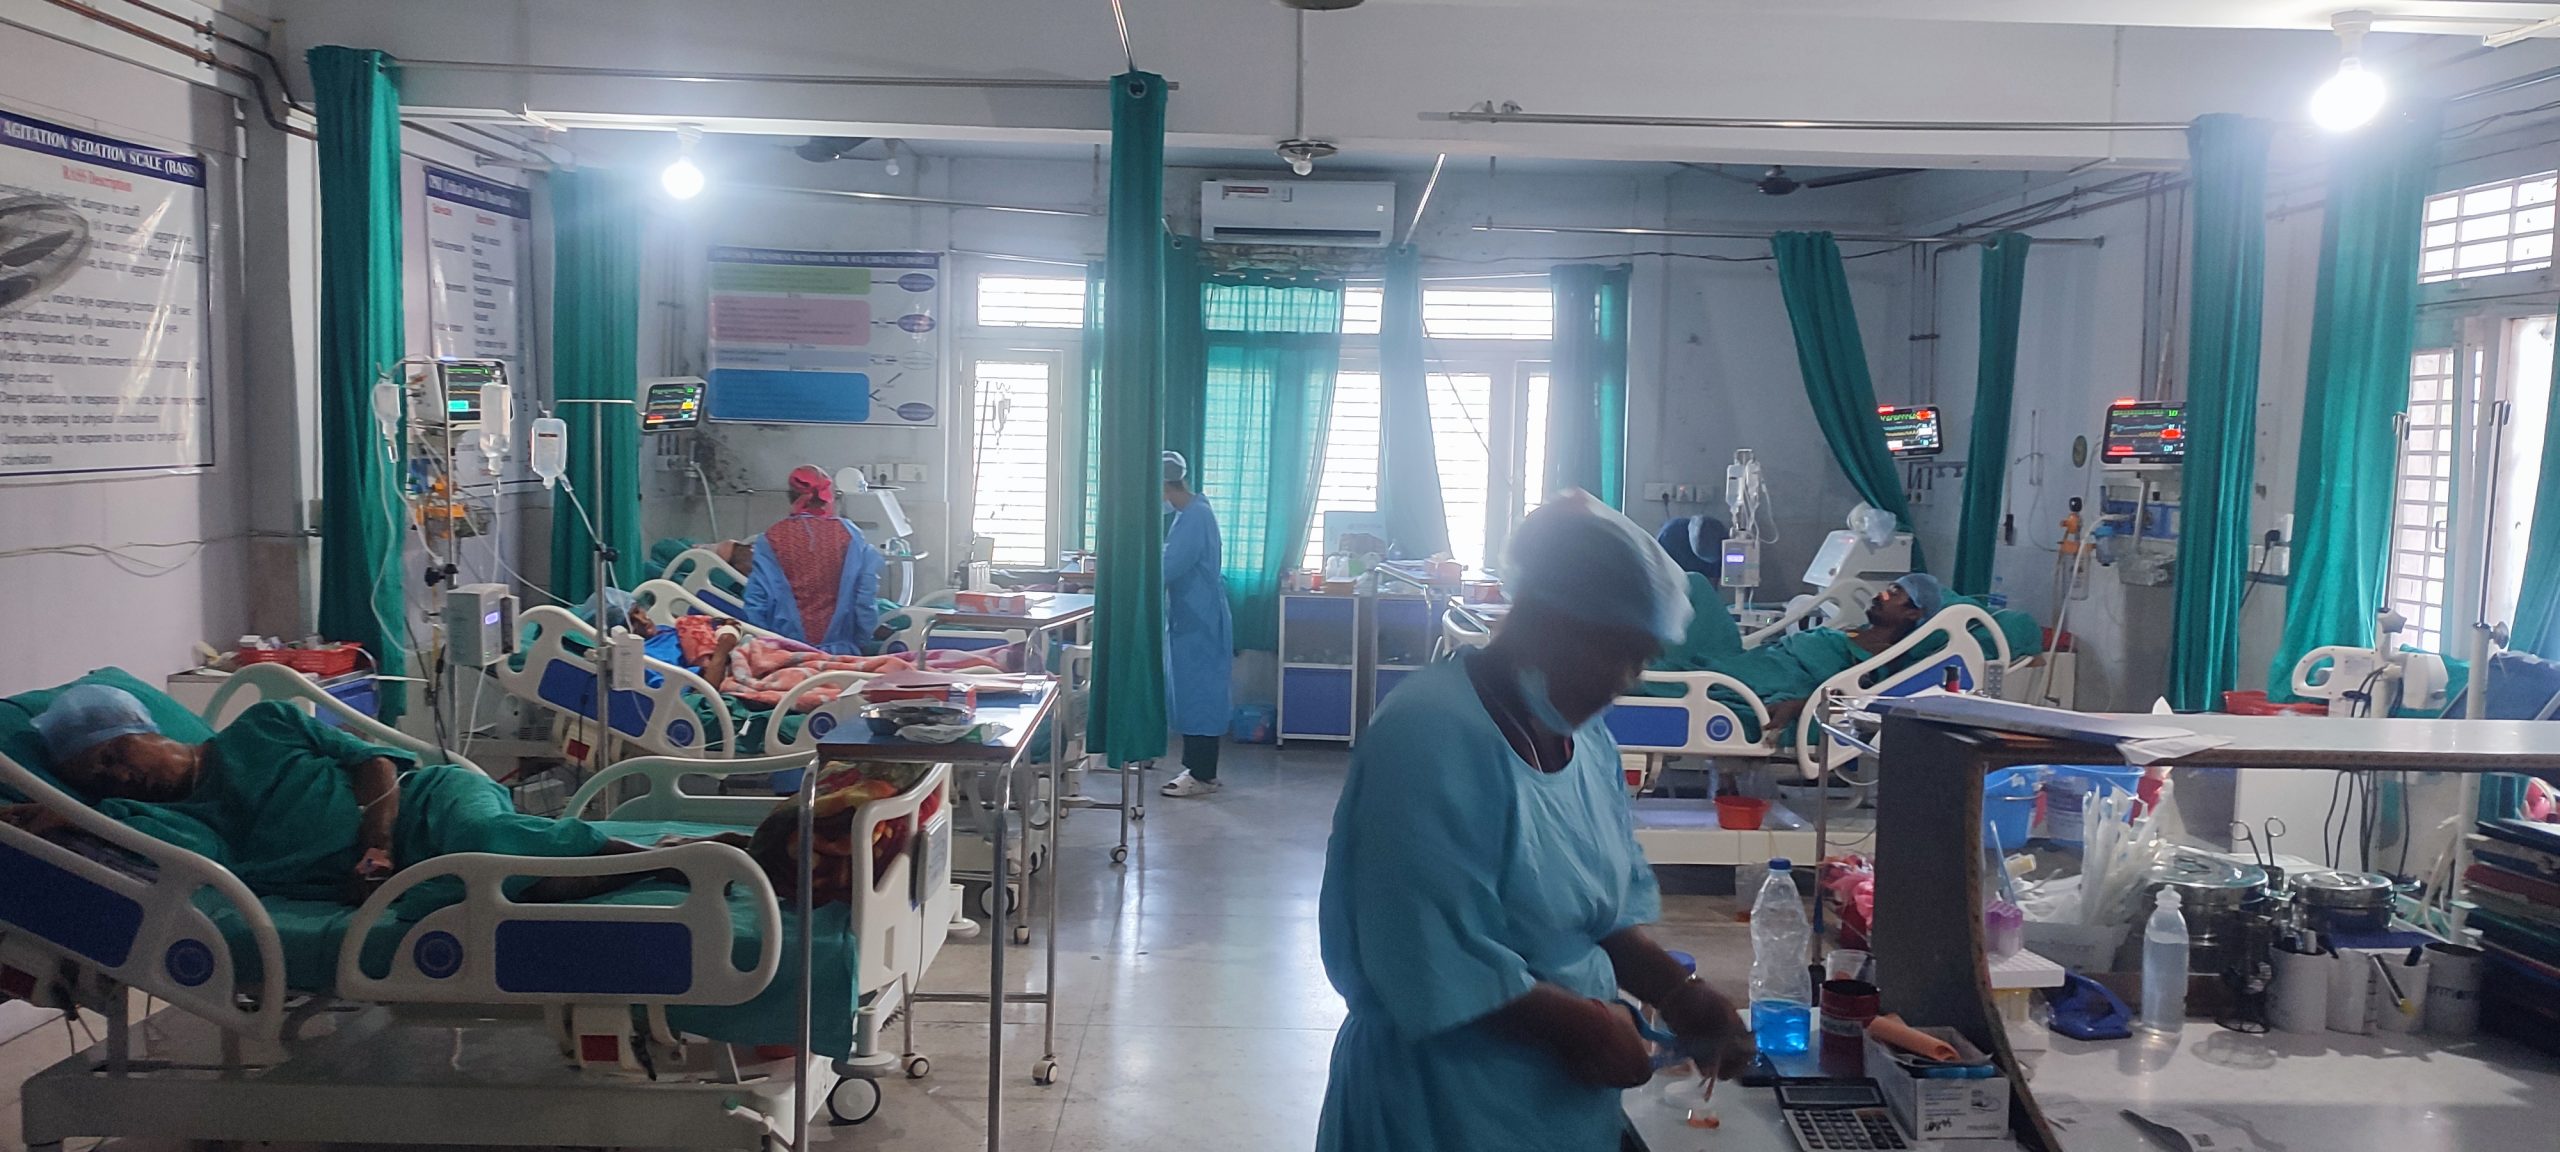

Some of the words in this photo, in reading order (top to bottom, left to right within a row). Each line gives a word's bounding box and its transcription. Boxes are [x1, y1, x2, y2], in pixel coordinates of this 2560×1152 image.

[4, 120, 68, 149] AGITATION
[71, 137, 126, 163] SEDATION
[129, 151, 164, 172] SCALE
[112, 203, 120, 214] to
[66, 312, 92, 329] briefly
[18, 373, 53, 384] contact
[12, 415, 28, 427] eye
[31, 415, 69, 427] opening
[71, 413, 81, 424] to
[62, 435, 73, 443] no
[75, 434, 112, 446] response
[114, 433, 122, 443] to
[124, 433, 145, 442] voice
[146, 433, 155, 442] or
[1, 454, 52, 466] stimulation
